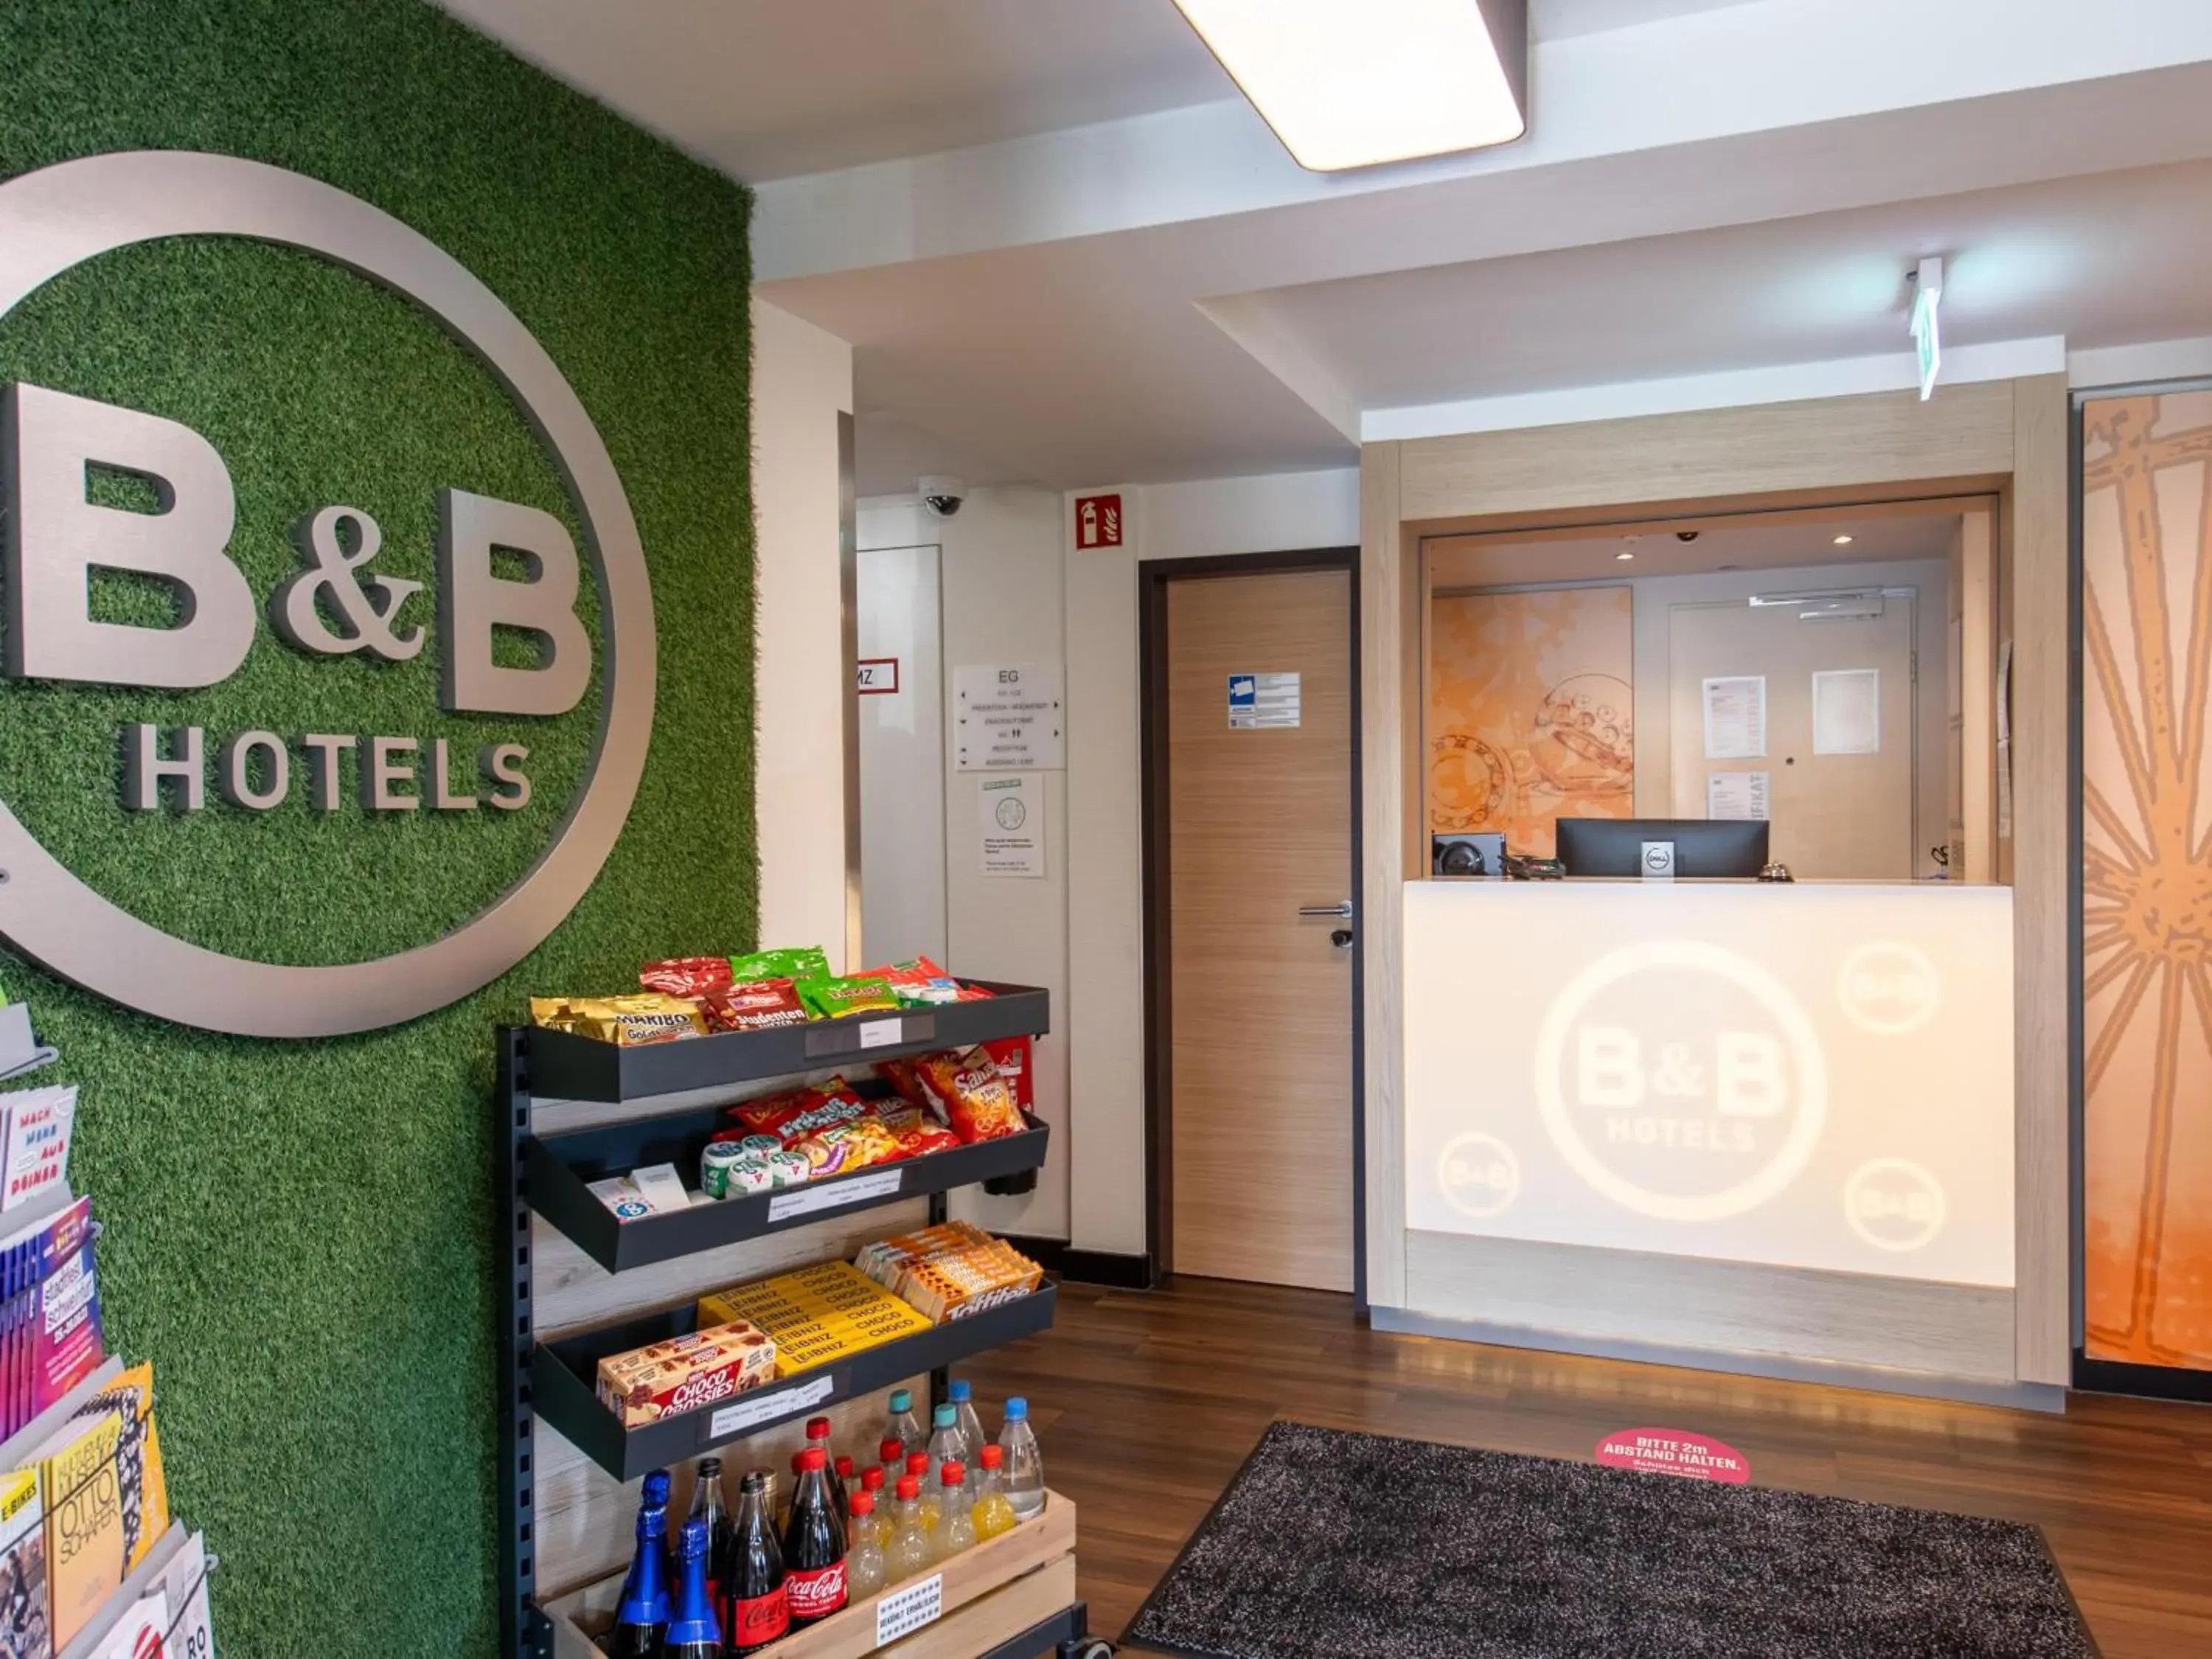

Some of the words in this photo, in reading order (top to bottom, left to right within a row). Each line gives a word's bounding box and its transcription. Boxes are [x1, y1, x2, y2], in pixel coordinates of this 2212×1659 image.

[13, 381, 592, 716] B&B
[998, 669, 1019, 684] EG
[133, 723, 532, 811] HOTELS
[735, 1009, 806, 1025] Studenten
[1578, 1026, 1788, 1117] B&B
[41, 1140, 64, 1160] AUS
[1604, 1116, 1756, 1153] HOTELS
[11, 1164, 58, 1196] DEINER
[728, 1290, 779, 1311] LEIBNIZ
[738, 1298, 791, 1318] LEIBNIZ
[826, 1287, 872, 1304] CHOCO
[771, 1324, 824, 1346] LEIBNIZ
[847, 1303, 893, 1320] CHOCO
[781, 1332, 834, 1355] LEIBNIZ
[855, 1312, 902, 1329] CHOCO
[792, 1340, 848, 1364] LEIBNIZ
[868, 1319, 915, 1337] CHOCO
[672, 1369, 728, 1405] CHOCO
[1604, 1442, 1675, 1461] ABSTAND
[1636, 1437, 1679, 1453] BITTE
[1682, 1443, 1708, 1455] 2m
[60, 1468, 114, 1539] OTTO
[783, 1565, 844, 1600] Coca-Cola
